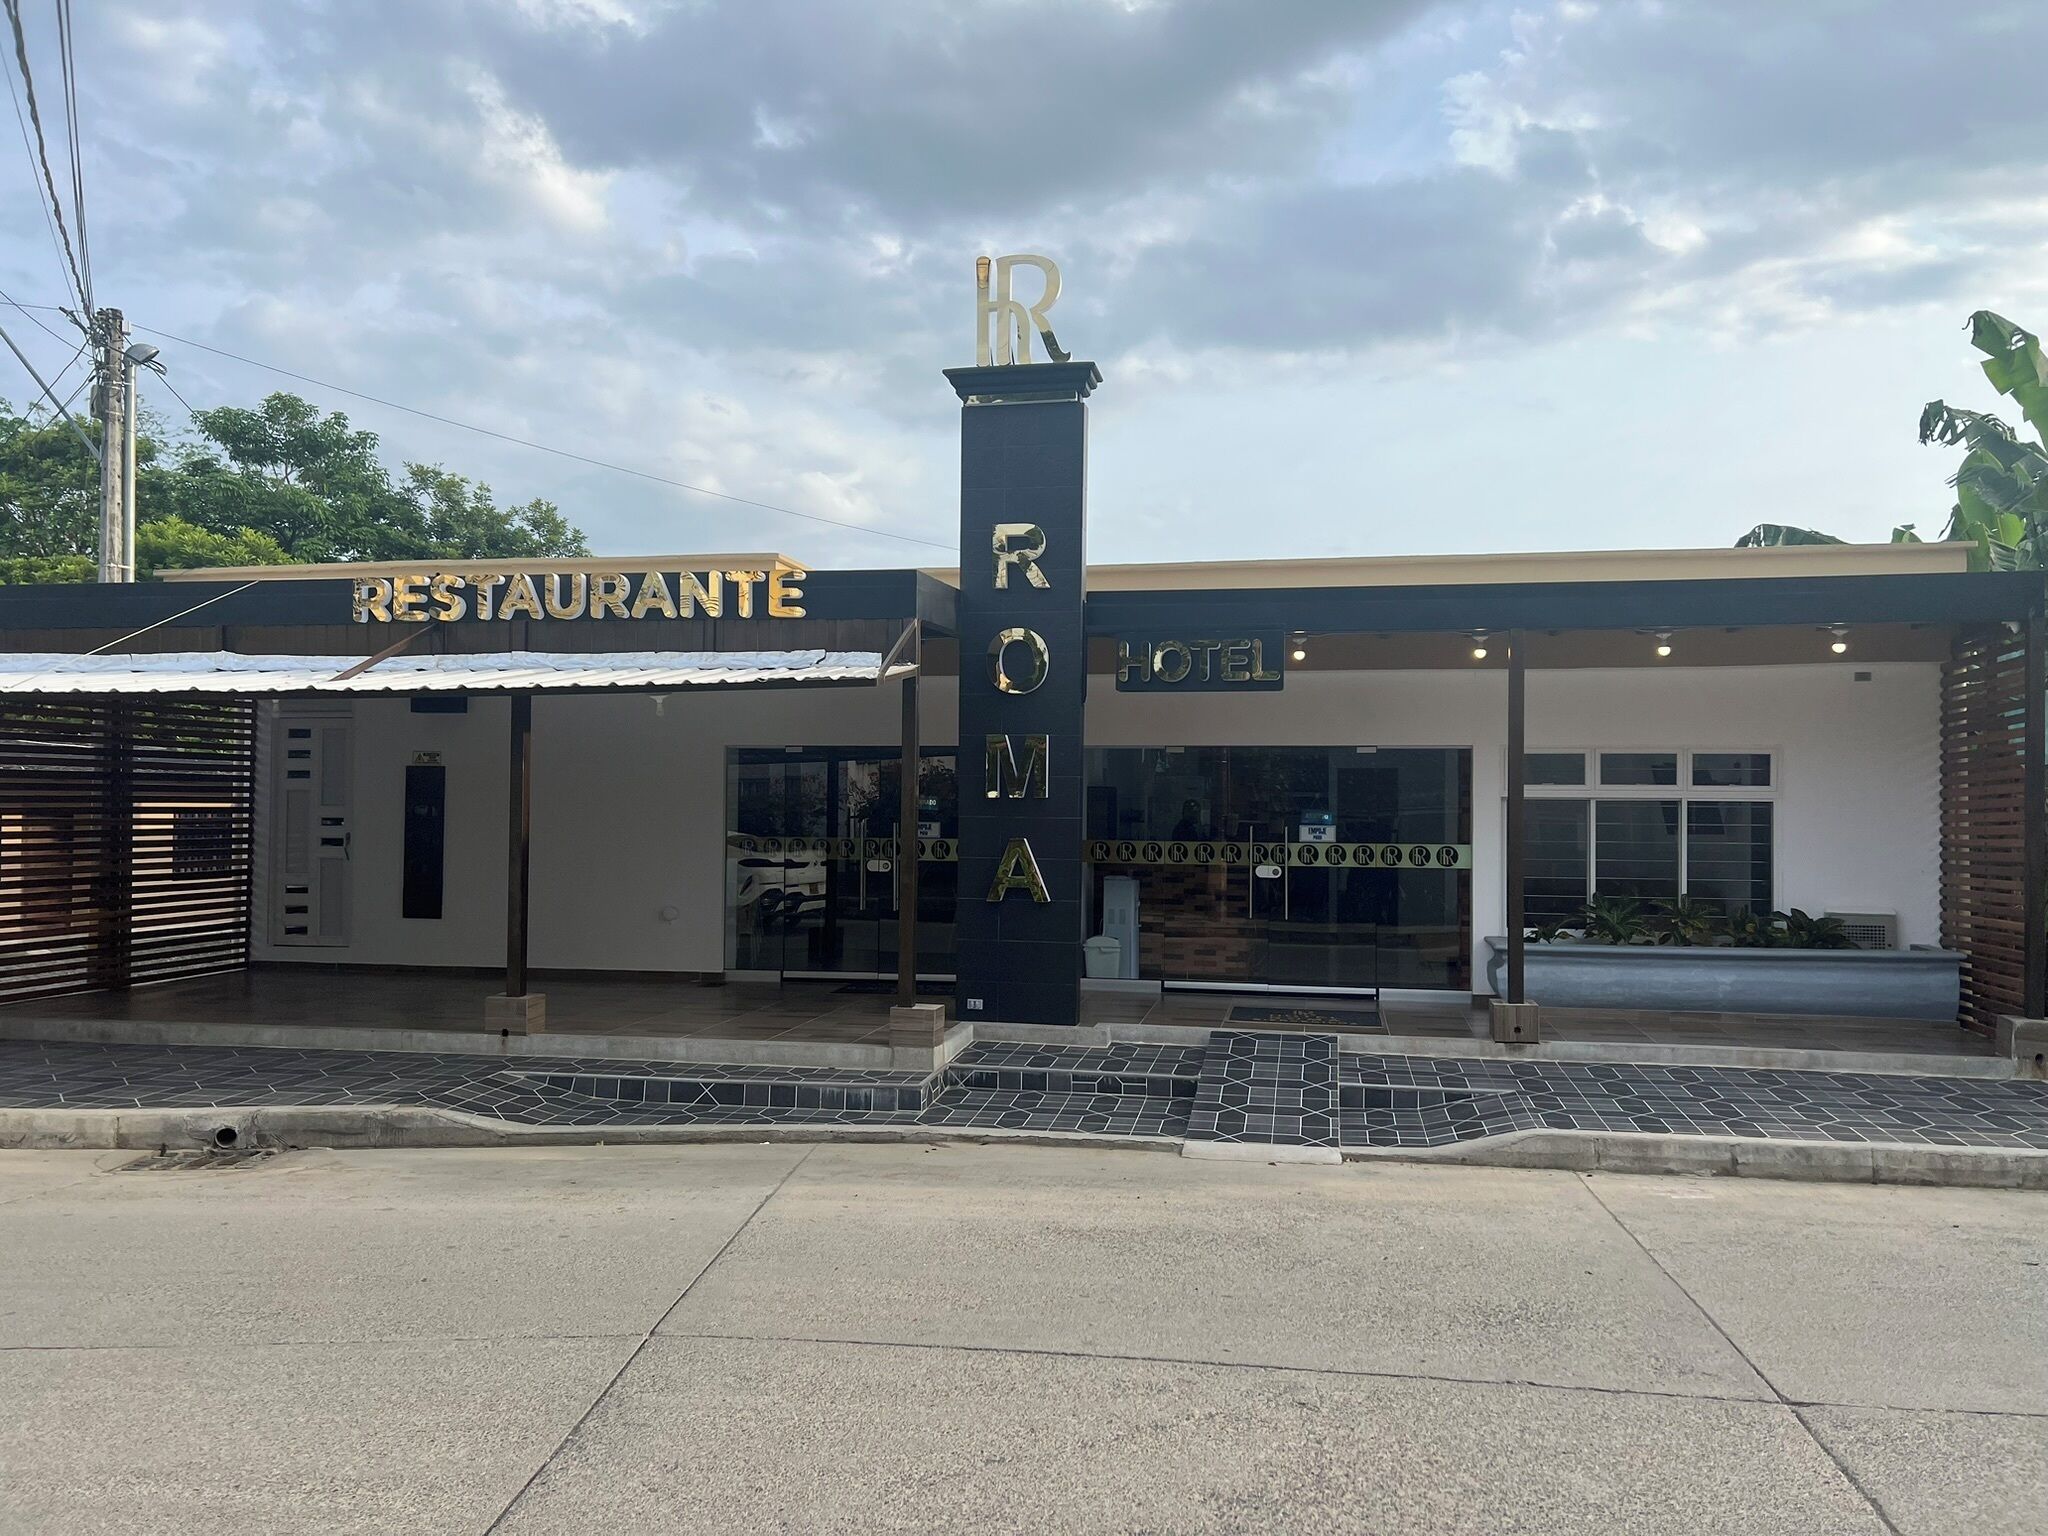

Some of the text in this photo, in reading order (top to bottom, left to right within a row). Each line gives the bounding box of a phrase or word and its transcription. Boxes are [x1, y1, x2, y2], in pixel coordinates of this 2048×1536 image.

[352, 569, 808, 624] RESTAURANTE
[1118, 638, 1281, 683] HOTEL
[986, 522, 1051, 903] ROMA
